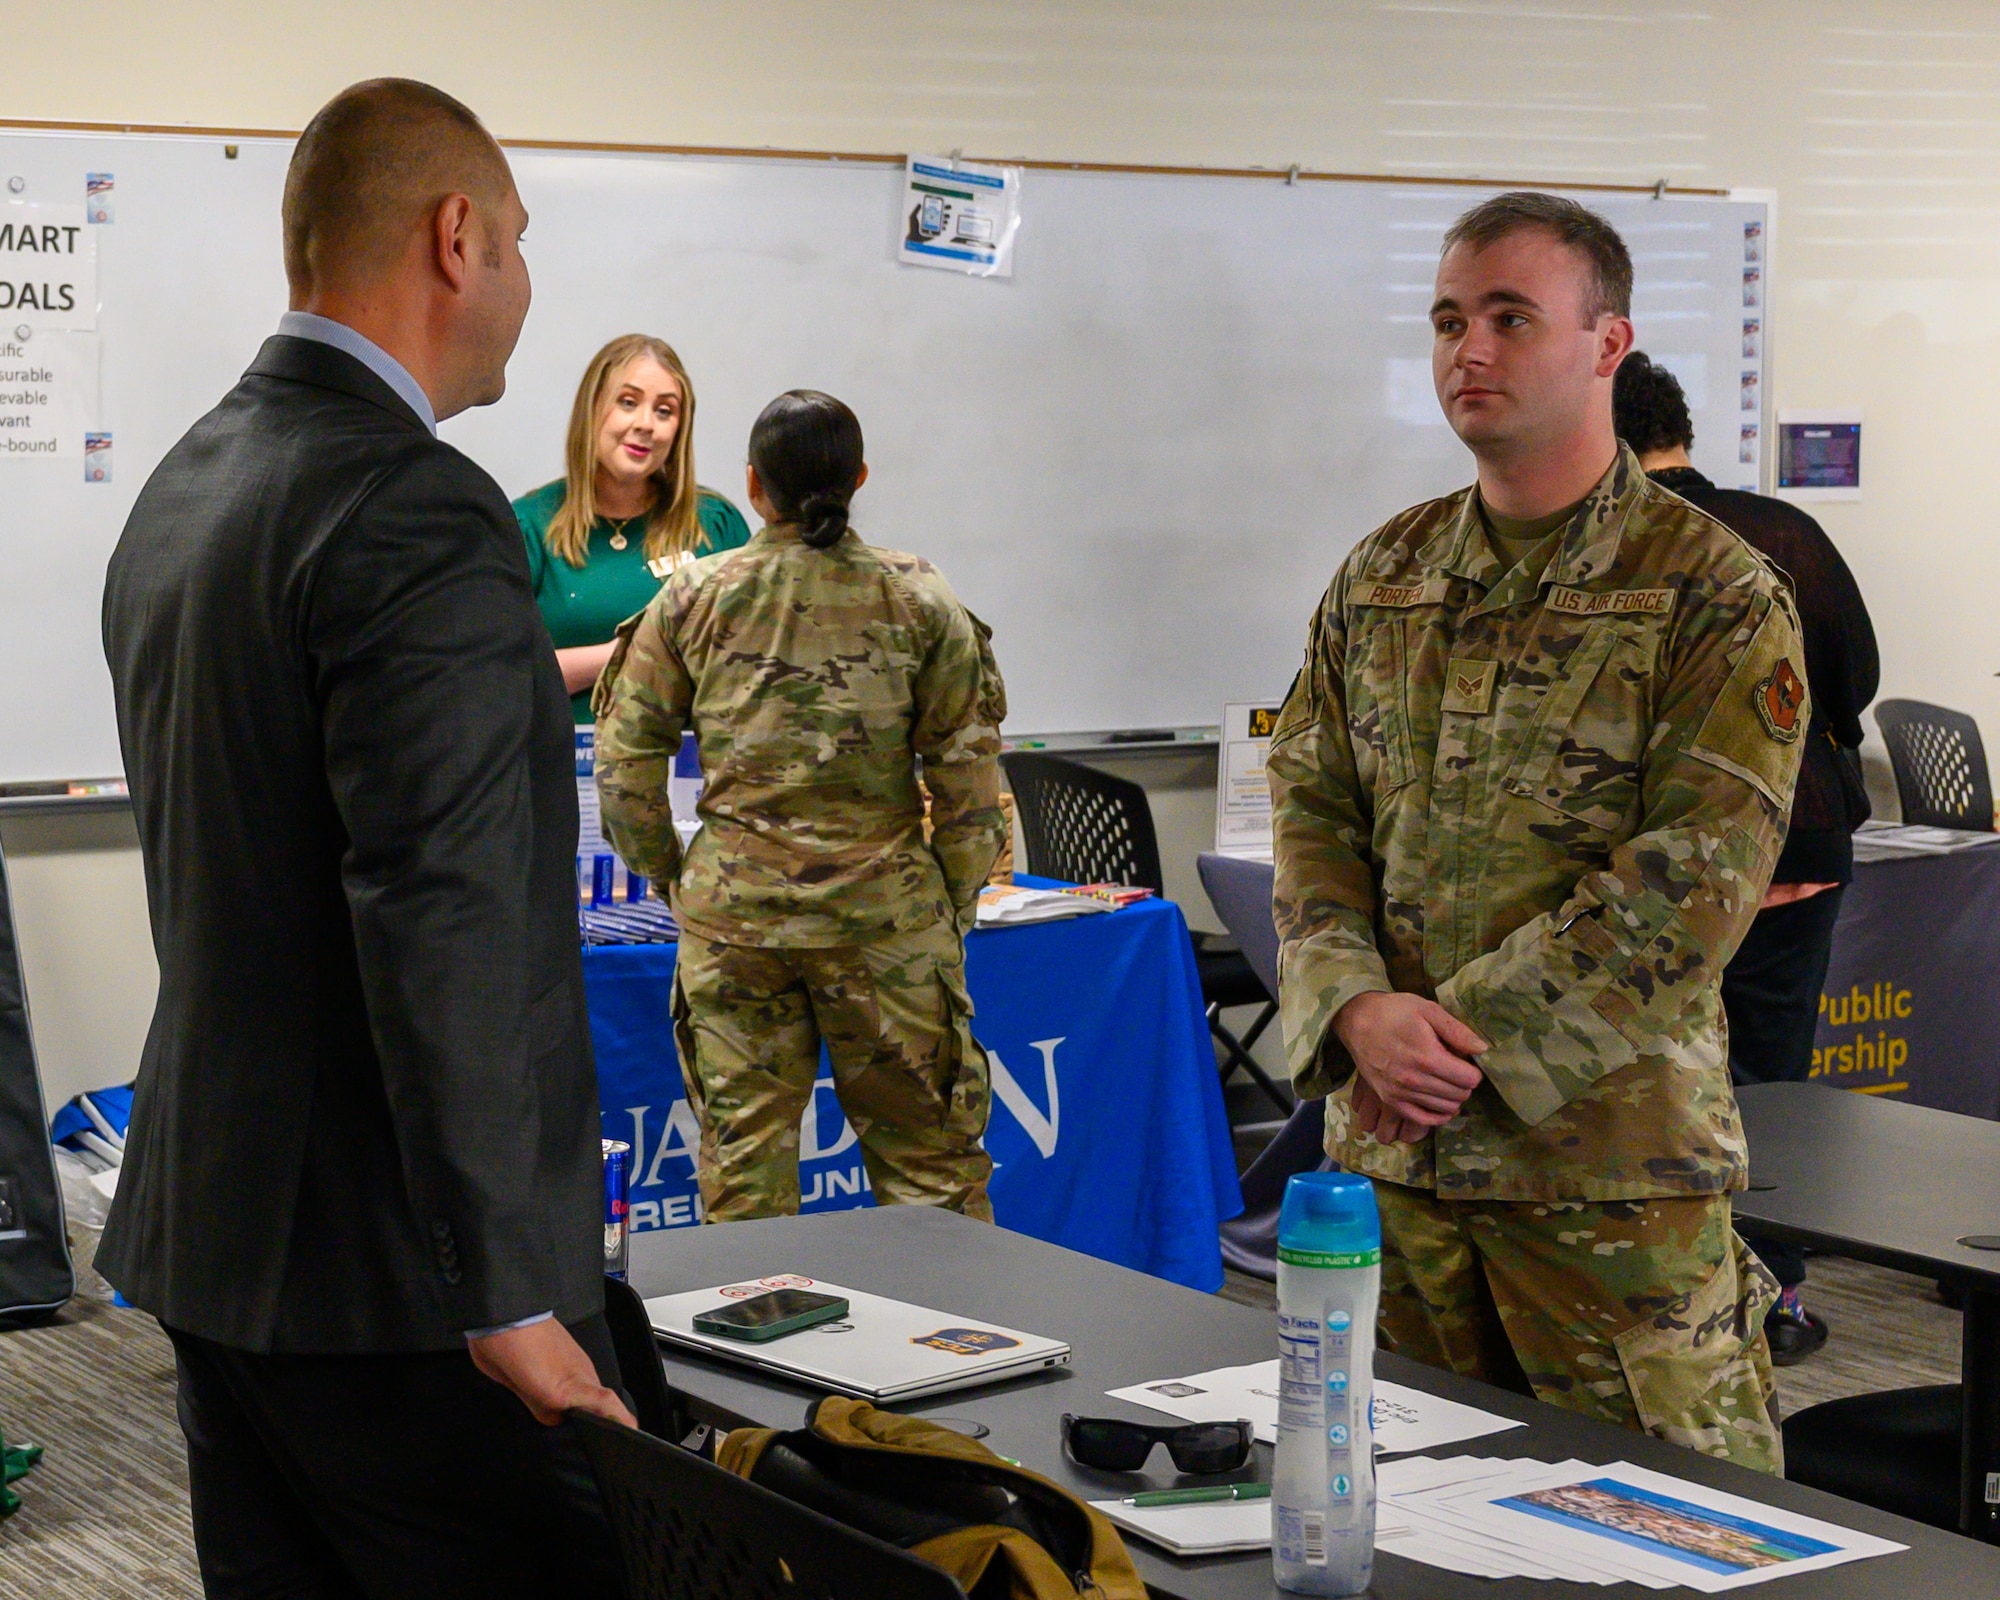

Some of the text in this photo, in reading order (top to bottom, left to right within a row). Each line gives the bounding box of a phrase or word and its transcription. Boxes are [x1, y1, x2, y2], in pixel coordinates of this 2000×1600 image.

[0, 343, 25, 358] ific
[1369, 586, 1425, 604] PORTER
[1553, 589, 1668, 612] U.S. AIR FORCE
